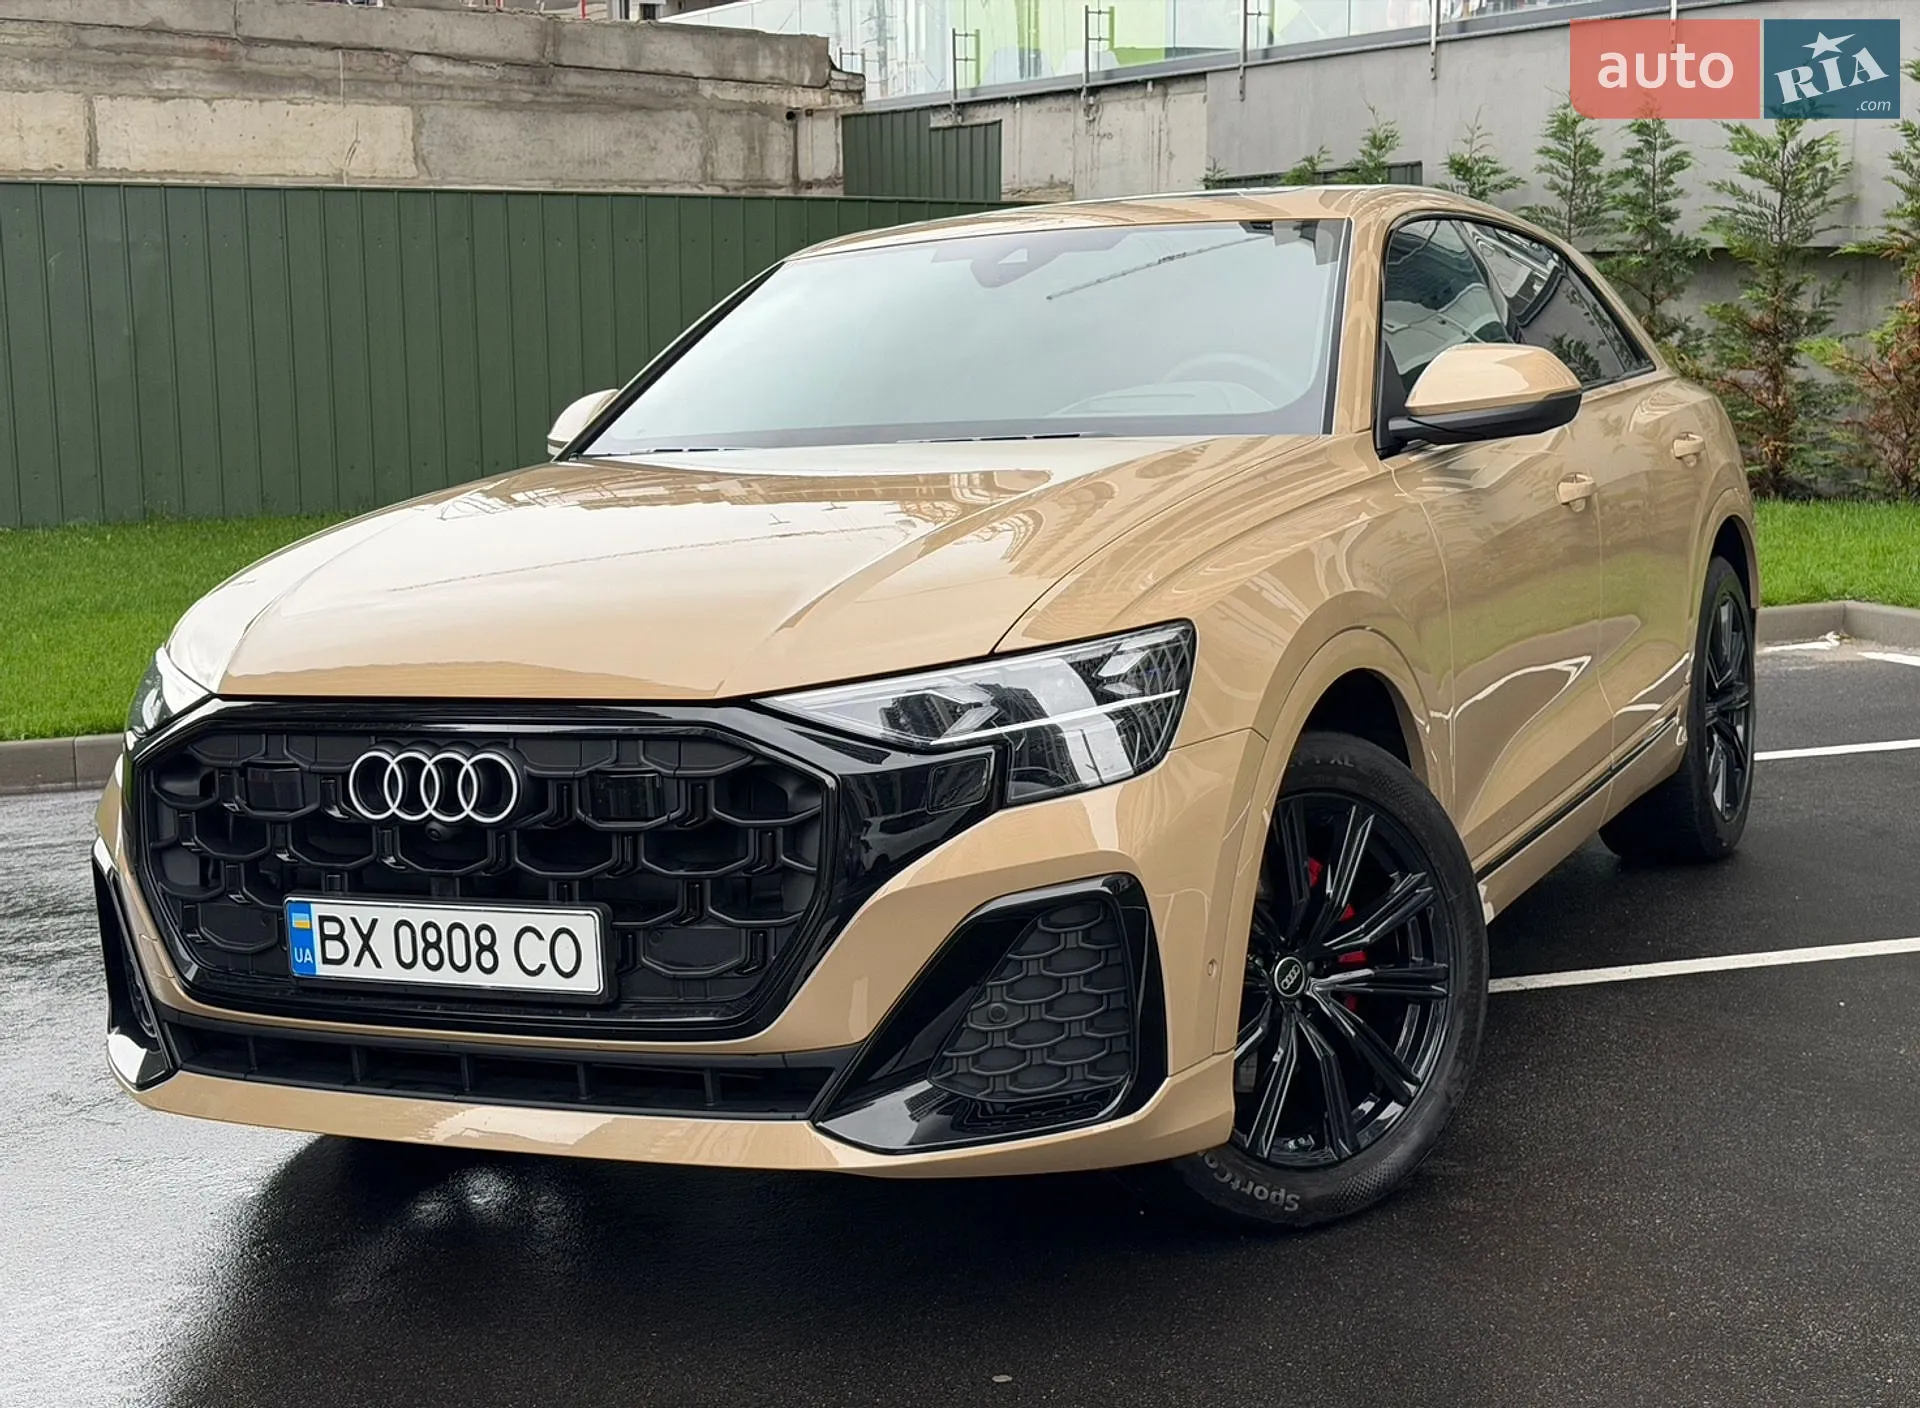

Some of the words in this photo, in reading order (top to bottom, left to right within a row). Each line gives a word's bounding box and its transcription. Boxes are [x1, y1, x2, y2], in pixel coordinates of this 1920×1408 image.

[294, 947, 314, 964] UA
[318, 915, 382, 969] BX
[394, 919, 499, 975] 0808
[513, 926, 582, 979] CO
[1200, 1152, 1300, 1212] SportCo
